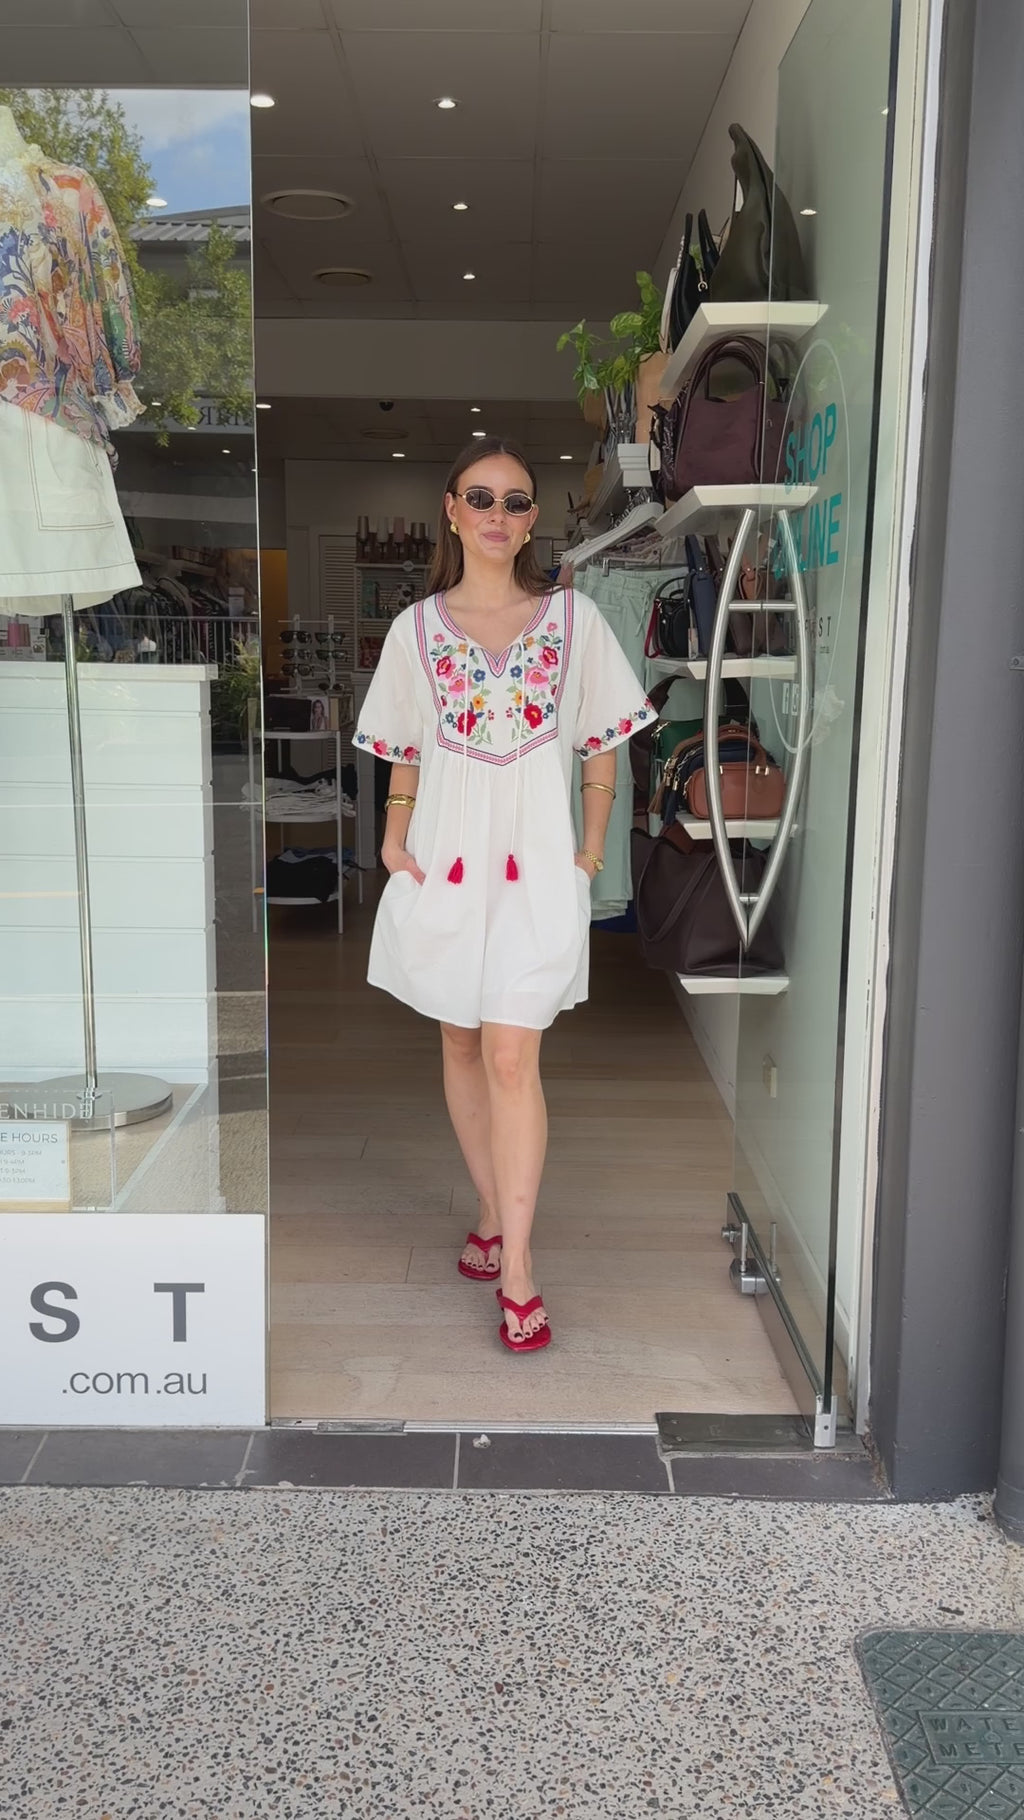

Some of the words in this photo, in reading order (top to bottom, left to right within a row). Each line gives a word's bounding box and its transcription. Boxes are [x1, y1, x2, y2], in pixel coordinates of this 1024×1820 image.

[784, 402, 837, 494] SHOP
[12, 1132, 58, 1144] HOURS
[62, 1372, 207, 1394] .com.au
